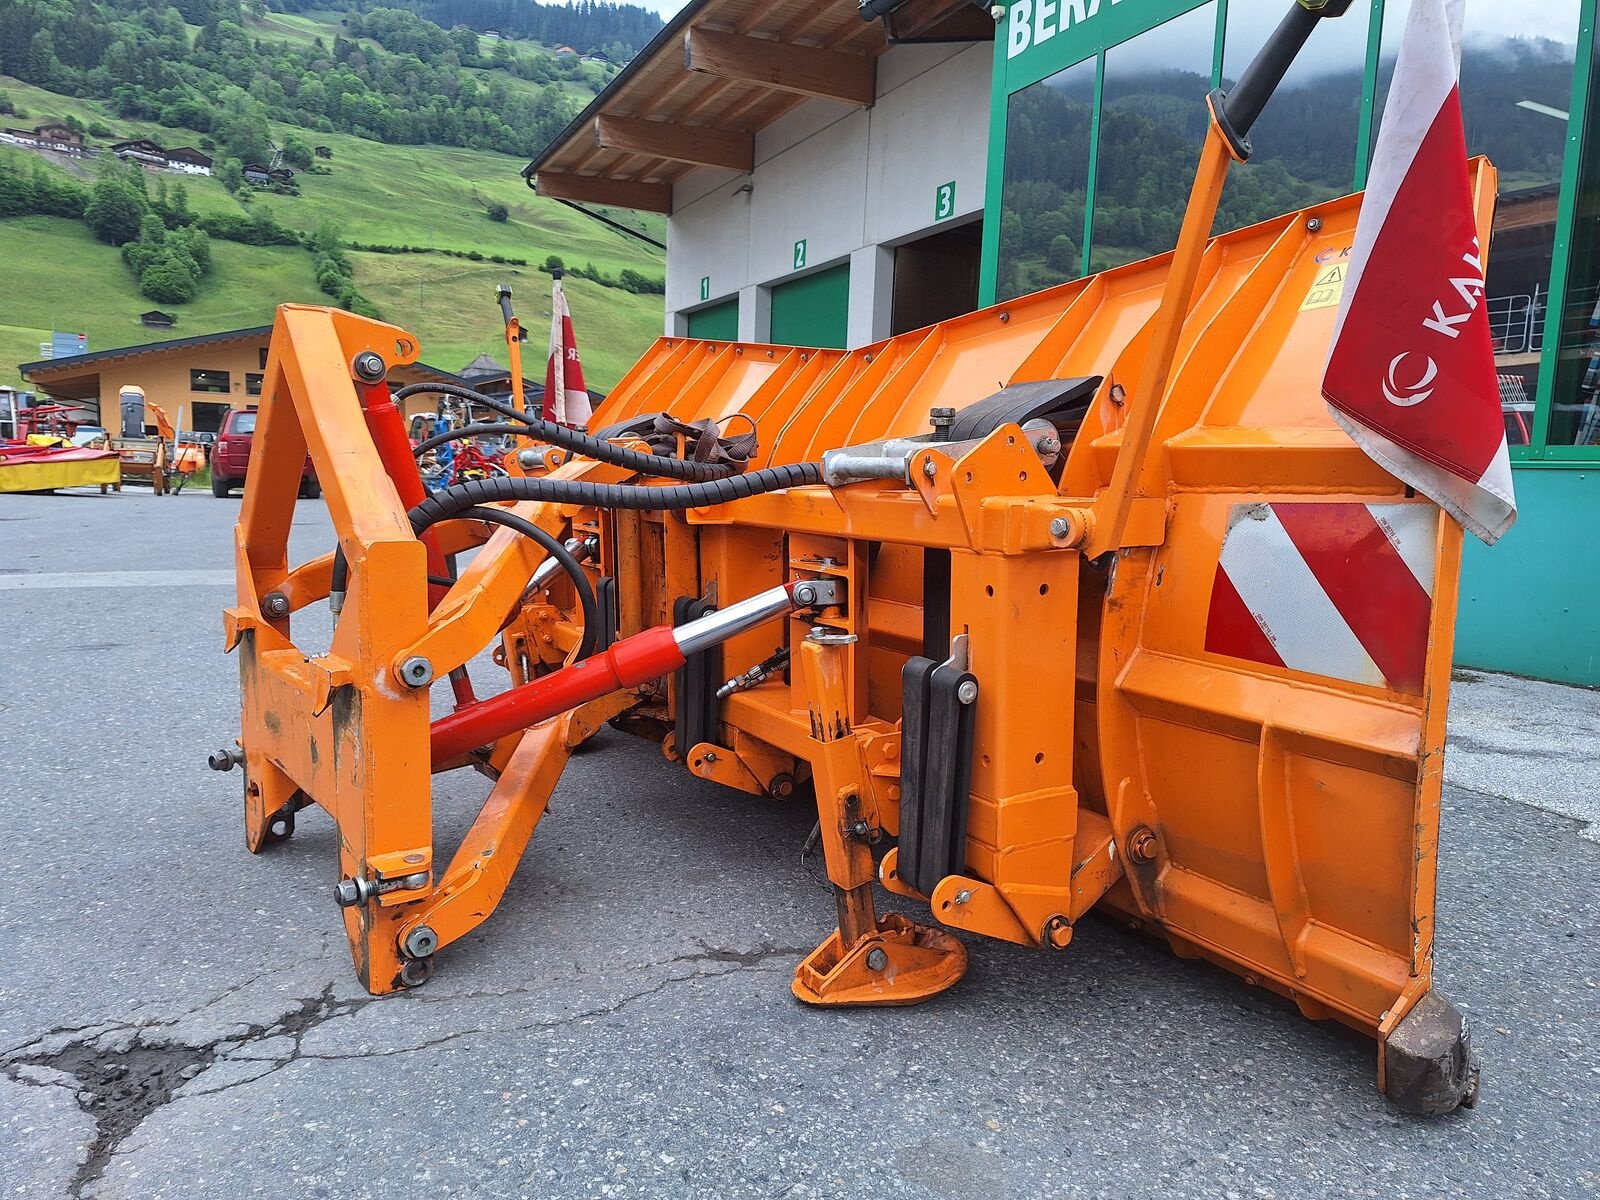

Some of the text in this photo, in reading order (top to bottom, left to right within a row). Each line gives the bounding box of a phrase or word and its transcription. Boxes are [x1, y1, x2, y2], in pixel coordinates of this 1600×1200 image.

[1007, 0, 1122, 60] BER
[939, 185, 951, 217] 3
[795, 242, 804, 268] 2
[702, 278, 708, 299] 1
